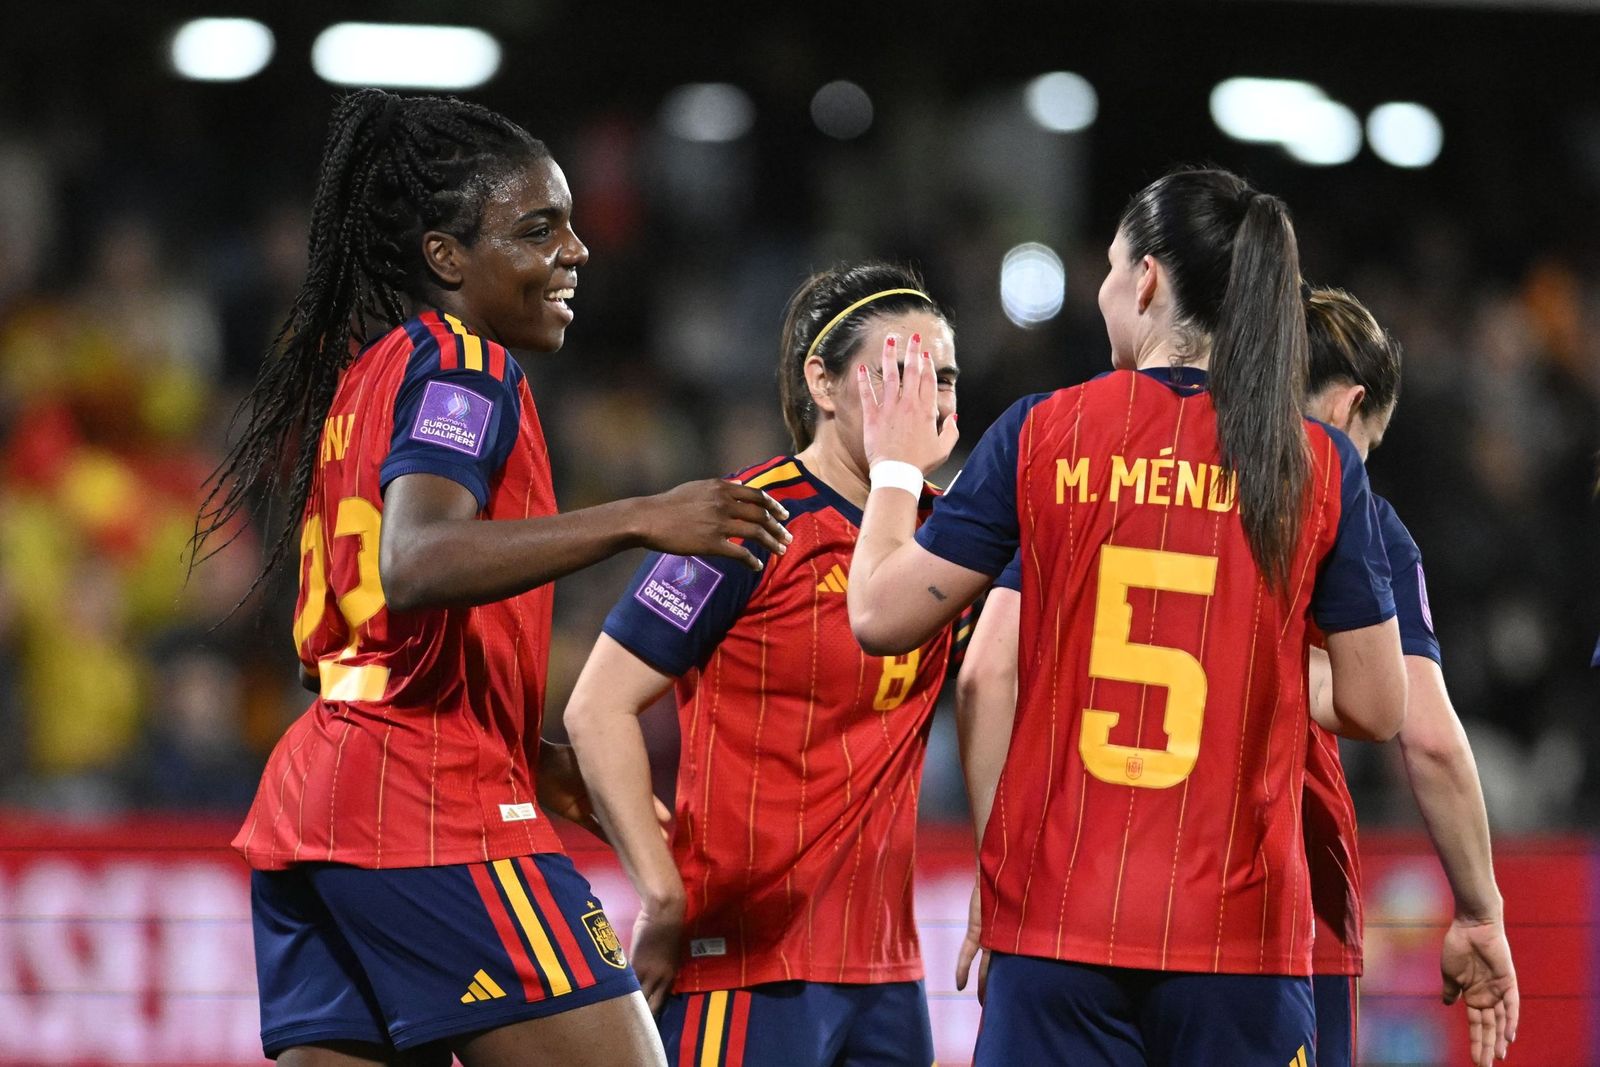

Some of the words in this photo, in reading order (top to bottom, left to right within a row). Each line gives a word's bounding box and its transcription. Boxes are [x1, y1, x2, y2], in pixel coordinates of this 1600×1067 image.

[420, 426, 475, 448] QUALIFIERS
[423, 419, 476, 440] EUROPEAN
[1055, 457, 1098, 504] M.
[1109, 447, 1240, 513] MÉND
[644, 586, 690, 621] QUALIFIERS
[649, 579, 693, 613] EUROPEAN
[1078, 544, 1219, 790] 5
